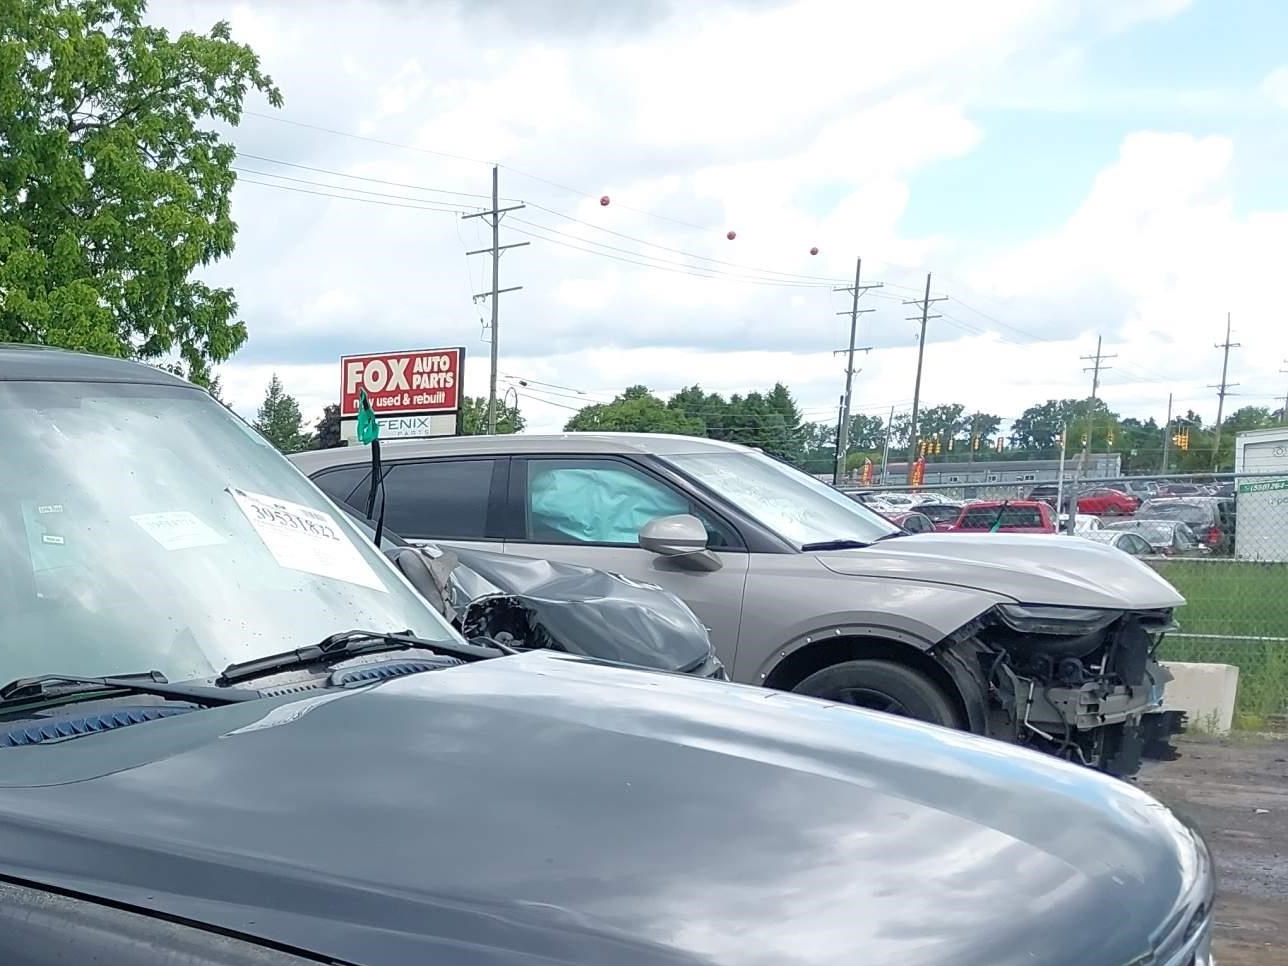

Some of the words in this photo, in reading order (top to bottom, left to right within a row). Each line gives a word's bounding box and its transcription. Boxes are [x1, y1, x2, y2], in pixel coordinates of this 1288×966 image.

[413, 355, 450, 373] AUTO
[347, 358, 411, 394] FOX
[412, 372, 454, 389] PARTS
[376, 394, 401, 407] used
[403, 393, 411, 405] &
[413, 391, 446, 404] rebuilt
[377, 418, 429, 430] FENIX
[251, 505, 341, 541] 39531822
